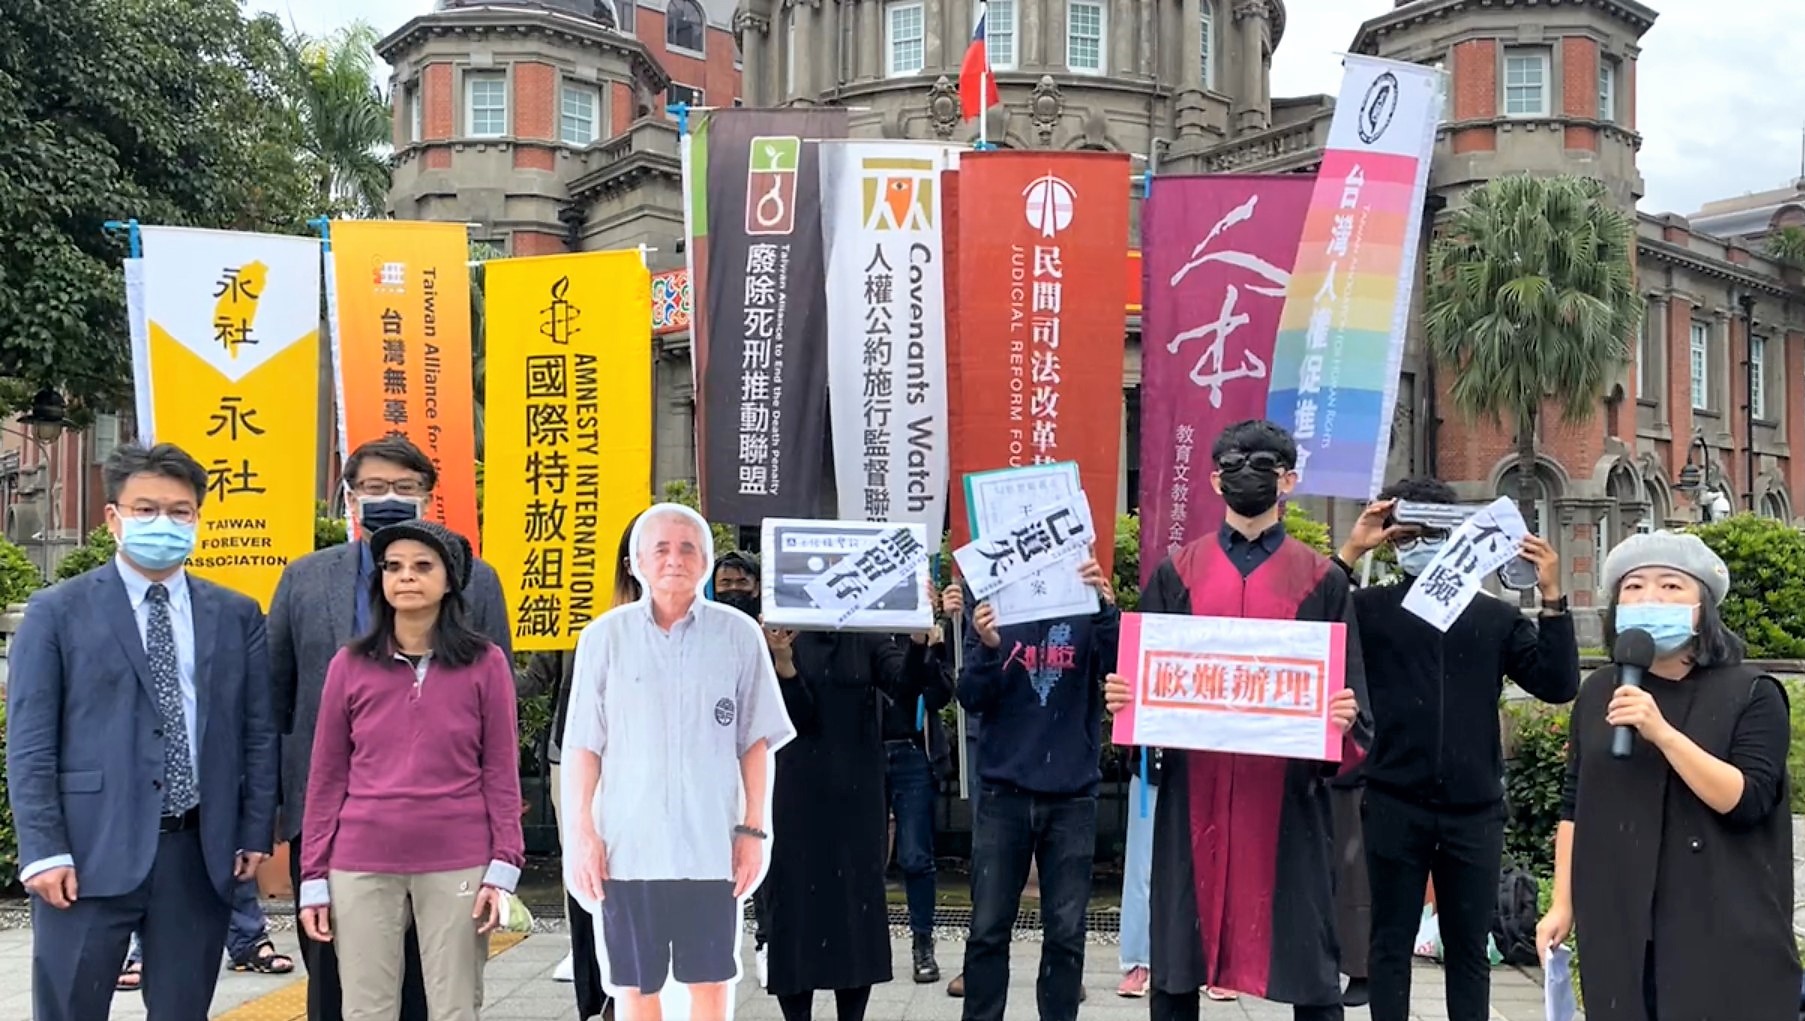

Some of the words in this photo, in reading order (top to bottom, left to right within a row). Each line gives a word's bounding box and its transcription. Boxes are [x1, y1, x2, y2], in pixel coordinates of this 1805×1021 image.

[423, 266, 437, 337] Taiwan
[779, 244, 790, 289] Taiwan
[1010, 244, 1025, 332] JUDICIAL
[212, 267, 260, 349] 永社
[775, 292, 787, 341] Alliance
[906, 242, 932, 405] Covenants
[424, 342, 442, 418] Alliance
[739, 243, 779, 495] 廢除死刑推動聯盟
[773, 360, 784, 383] End
[774, 343, 784, 357] to
[863, 243, 894, 522] 人權公約施行監督聯
[1009, 341, 1024, 421] REFORM
[1030, 244, 1063, 465] 民間司法改革
[574, 354, 599, 455] AMNESTY
[771, 386, 782, 407] the
[771, 410, 781, 446] Death
[206, 397, 266, 502] 永社
[427, 425, 442, 453] for
[769, 449, 780, 495] Penalty
[906, 415, 934, 512] Watch
[206, 518, 267, 530] TAIWAN
[516, 354, 570, 637] 國際特赦組織
[184, 554, 288, 568] ASSOCIATION
[201, 536, 272, 549] FOREVER
[567, 464, 599, 637] INTERNATIONAL
[826, 527, 924, 600] 無留存
[975, 508, 1085, 577] 已遺失
